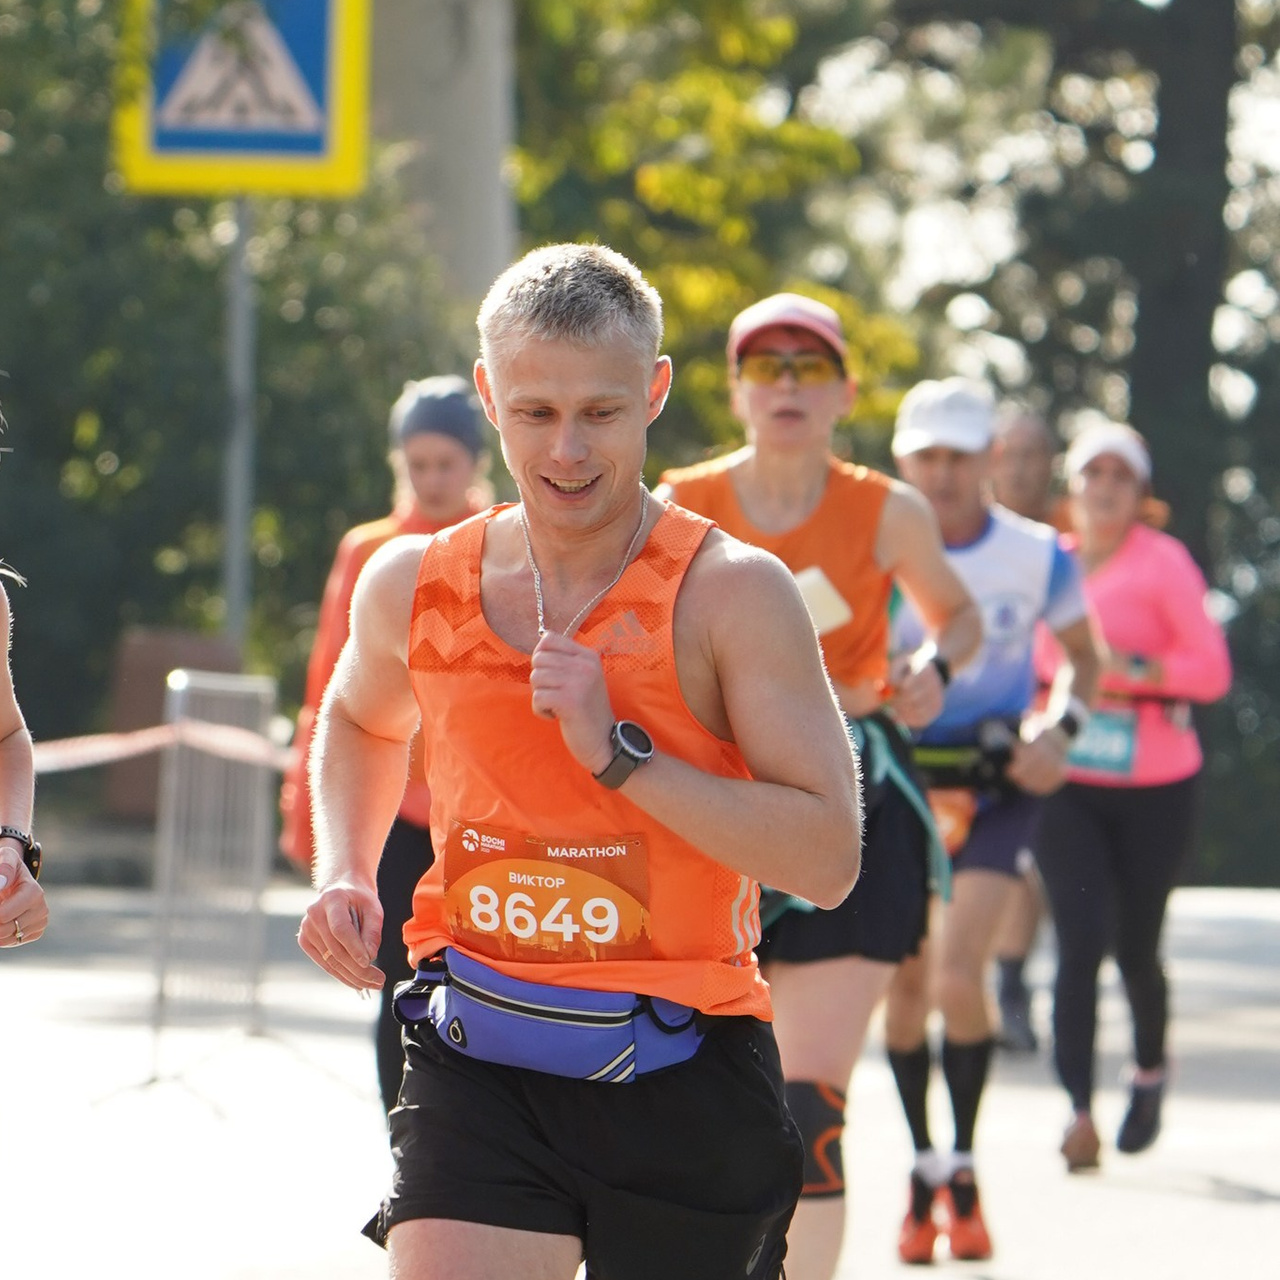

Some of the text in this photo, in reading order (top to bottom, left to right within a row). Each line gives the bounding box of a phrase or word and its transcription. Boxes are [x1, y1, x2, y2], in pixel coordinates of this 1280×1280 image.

[481, 834, 505, 847] SOCHI
[547, 845, 627, 858] MARATHON
[508, 871, 565, 889] ВИКТОР
[469, 885, 619, 944] 8649
